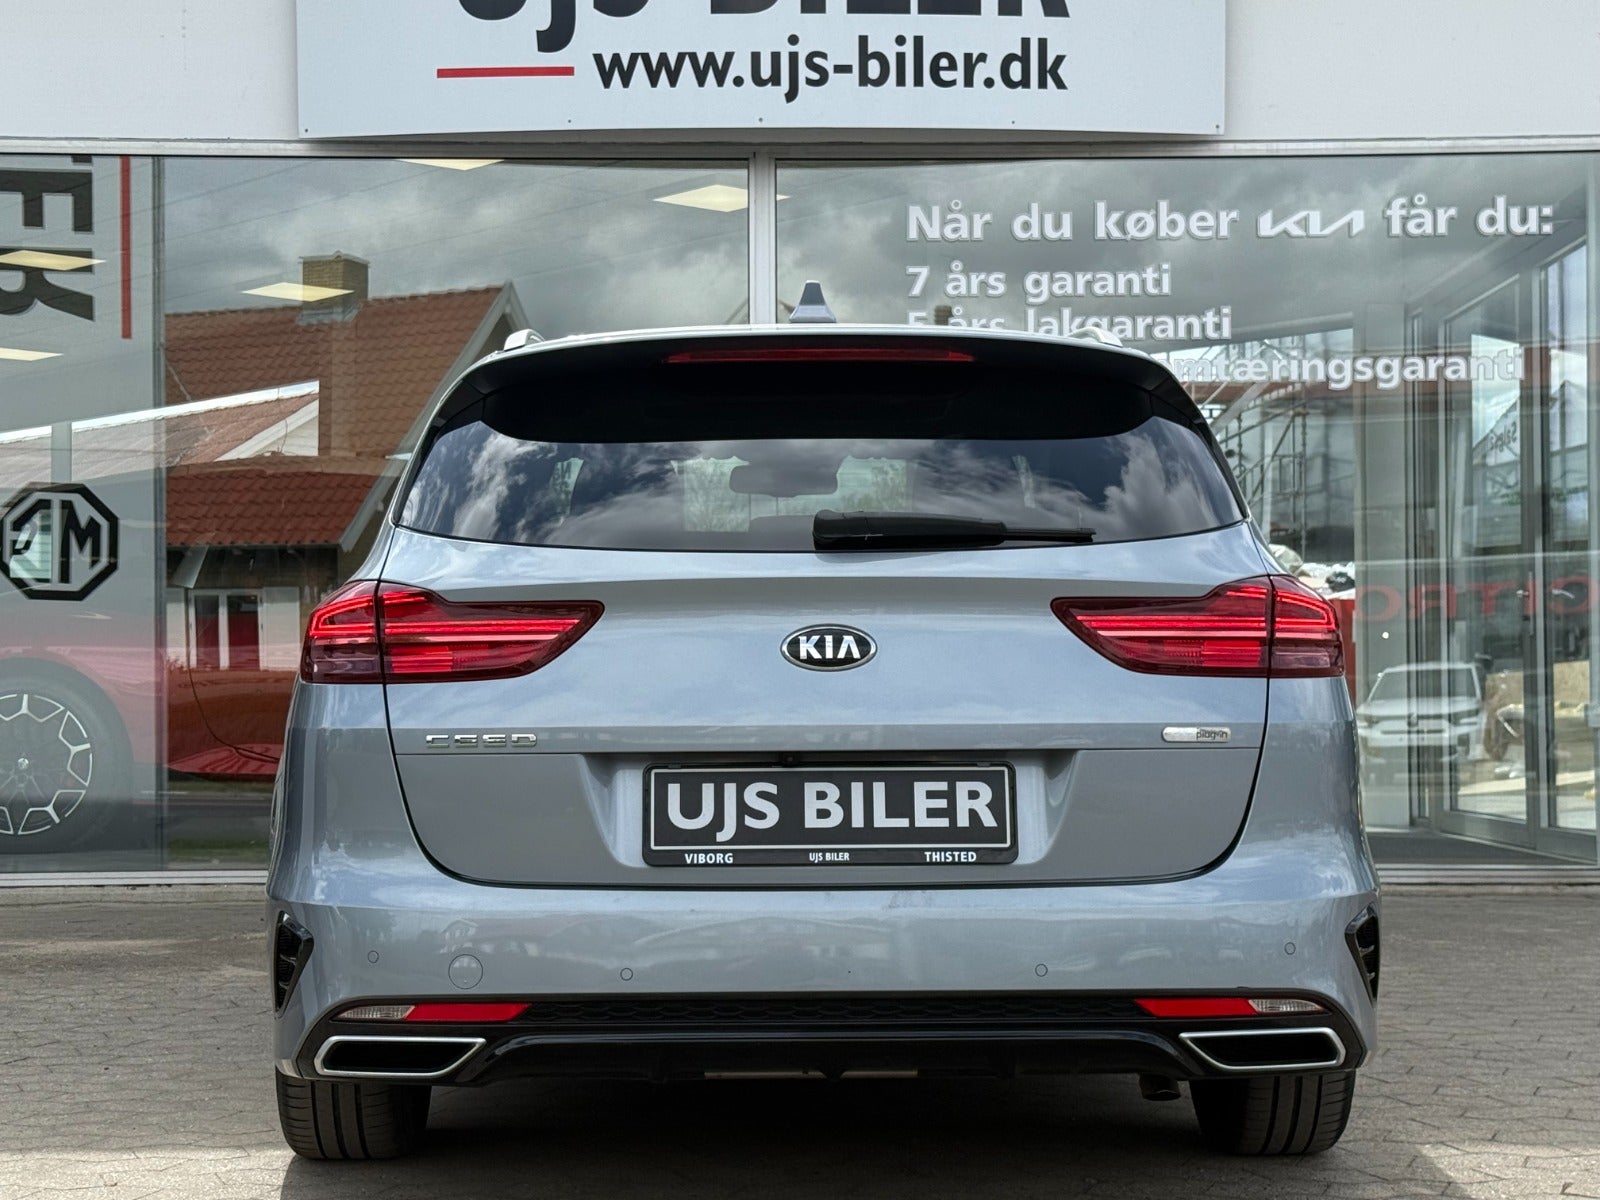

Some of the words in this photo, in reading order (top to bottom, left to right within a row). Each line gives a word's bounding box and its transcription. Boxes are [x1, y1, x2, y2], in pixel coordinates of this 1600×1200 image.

[592, 33, 1068, 104] www.ujs-biler.dk
[906, 199, 992, 241] Når
[1011, 202, 1072, 240] du
[1095, 199, 1239, 241] køber
[1384, 194, 1457, 236] får
[1476, 195, 1553, 236] du:
[906, 265, 930, 297] 7
[945, 260, 1007, 296] års
[1023, 262, 1172, 304] garanti
[799, 635, 861, 660] KIA
[666, 781, 781, 843] UJS
[803, 780, 998, 829] BILER
[684, 853, 734, 864] VIBORG
[809, 852, 823, 862] UJS
[825, 852, 850, 861] BILER
[924, 851, 977, 863] THISTED
